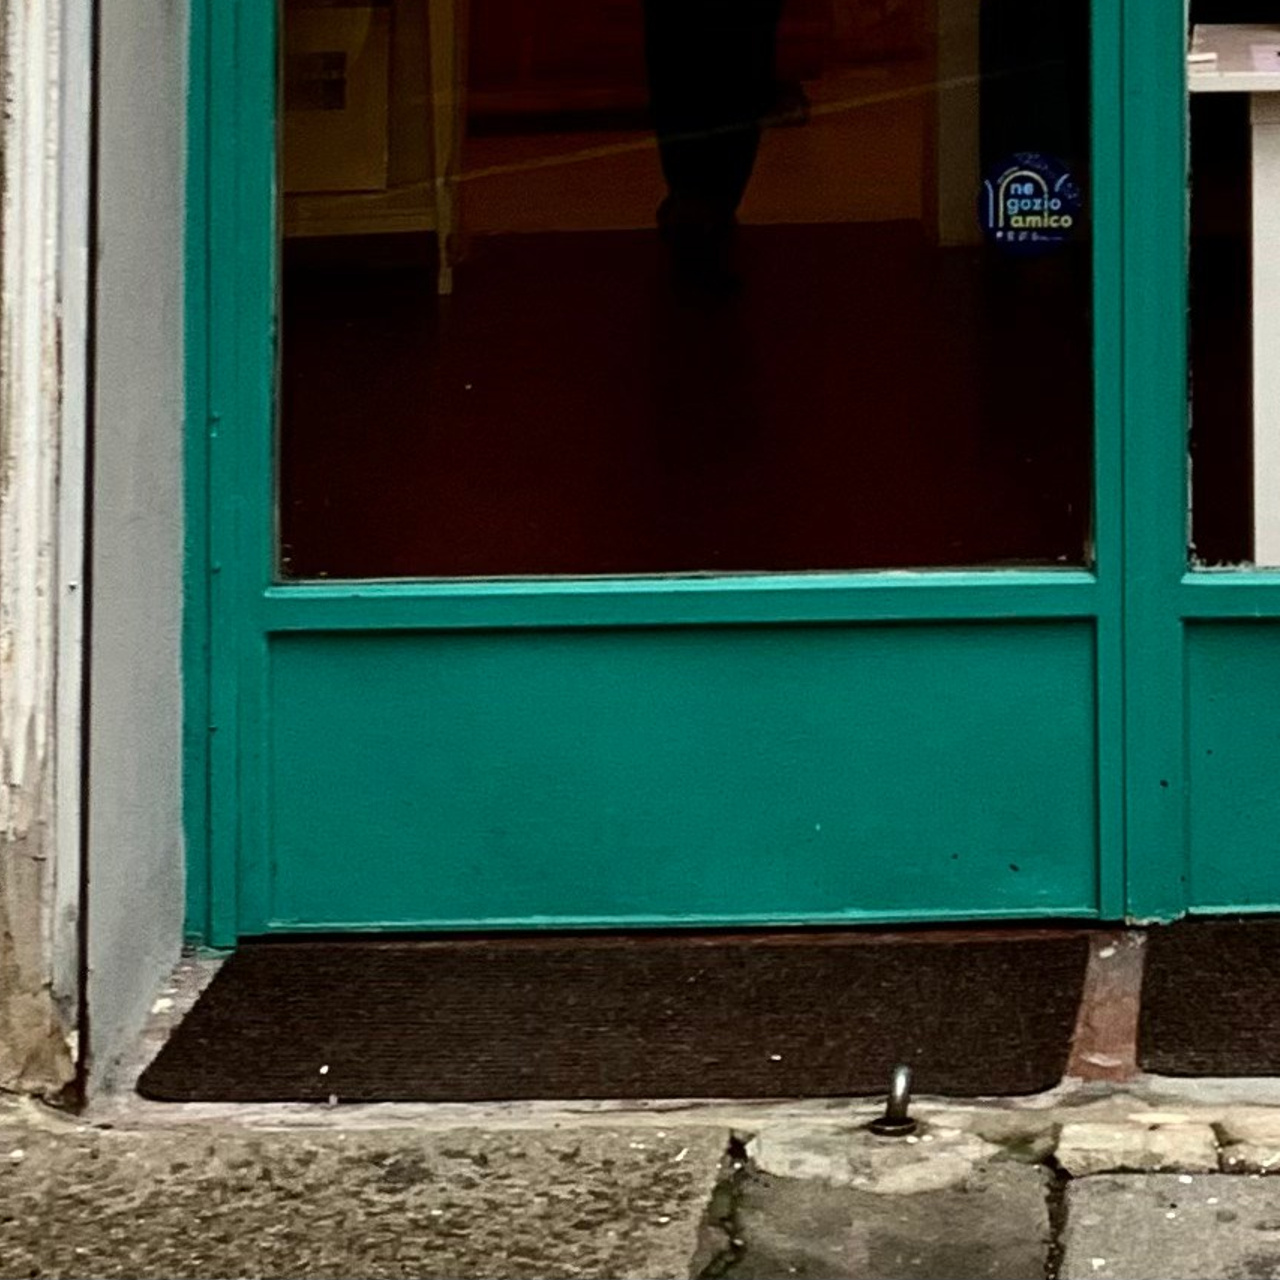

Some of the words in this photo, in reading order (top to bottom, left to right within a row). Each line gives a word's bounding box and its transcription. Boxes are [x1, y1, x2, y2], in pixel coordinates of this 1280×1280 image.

[1009, 182, 1035, 195] ne
[1006, 197, 1063, 215] gozio
[1010, 215, 1074, 229] amico
